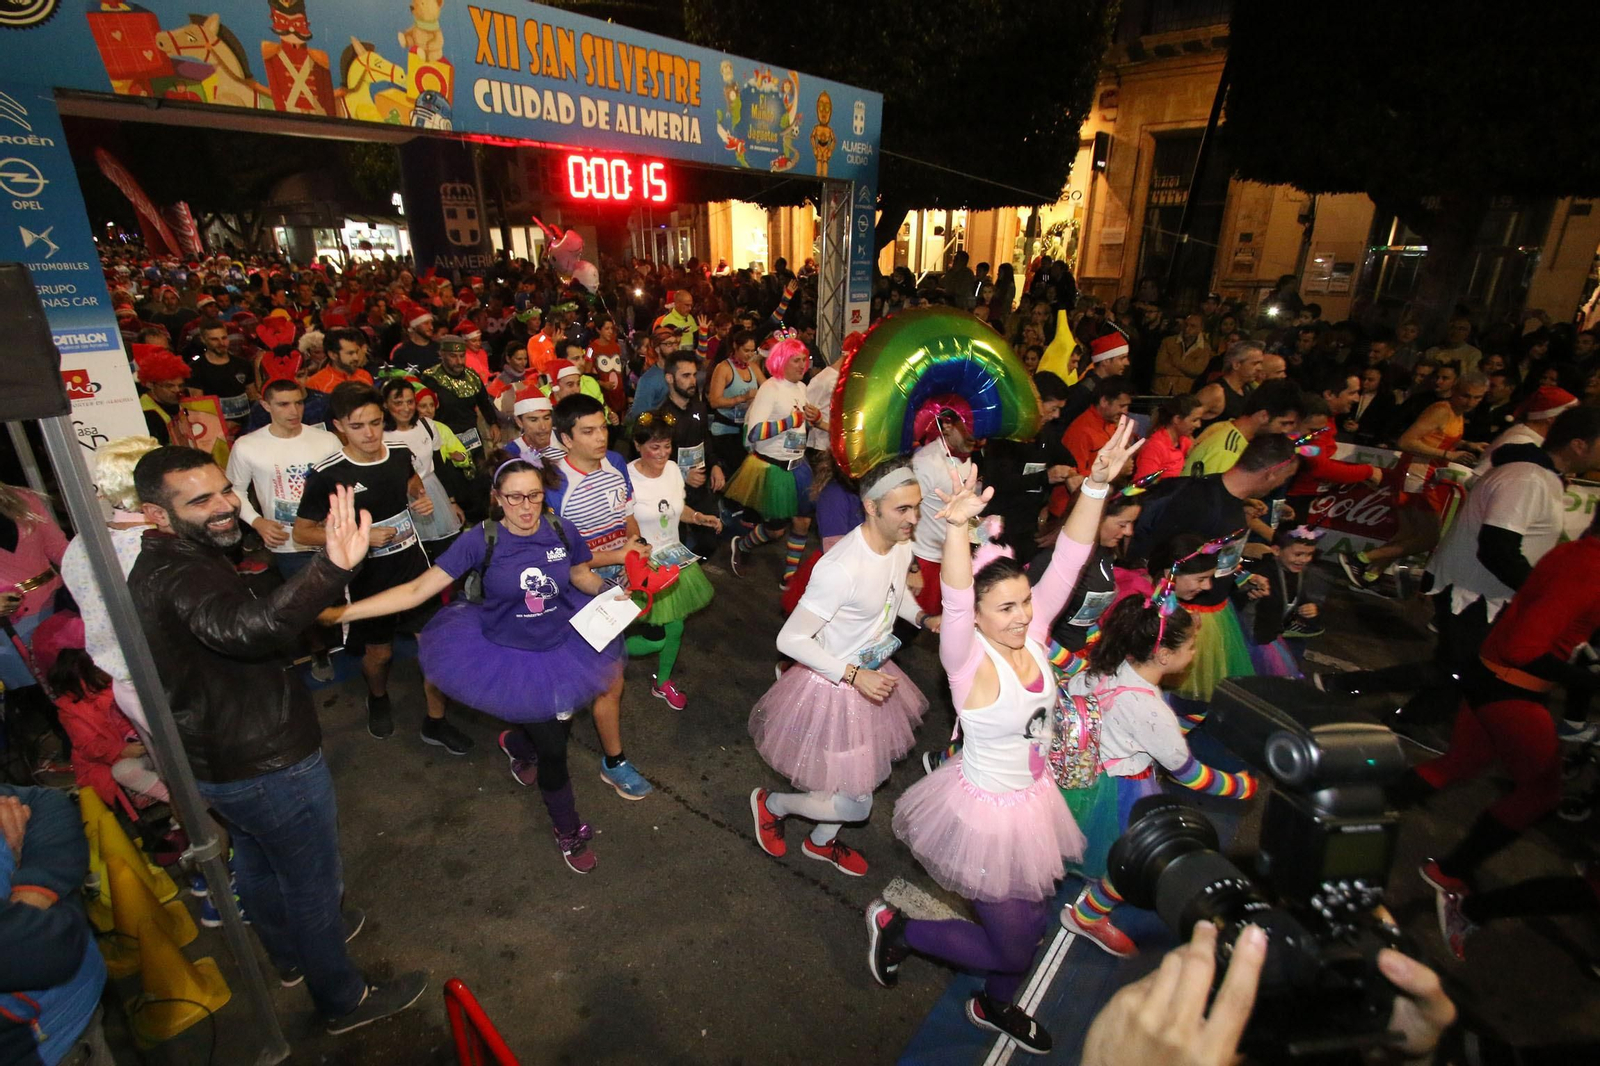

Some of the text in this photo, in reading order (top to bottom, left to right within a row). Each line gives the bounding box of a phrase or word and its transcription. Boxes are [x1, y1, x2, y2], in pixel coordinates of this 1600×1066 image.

[467, 4, 701, 108] XII SAN SILVESTRE
[473, 77, 702, 145] CIUDAD DE ALMERÍA
[0, 134, 55, 147] ROËN
[841, 139, 874, 155] ALMERÍA
[12, 200, 44, 211] OPEL
[27, 262, 90, 271] UTOMOBILES
[42, 296, 99, 308] NAS CAR
[53, 332, 108, 346] CATHLON
